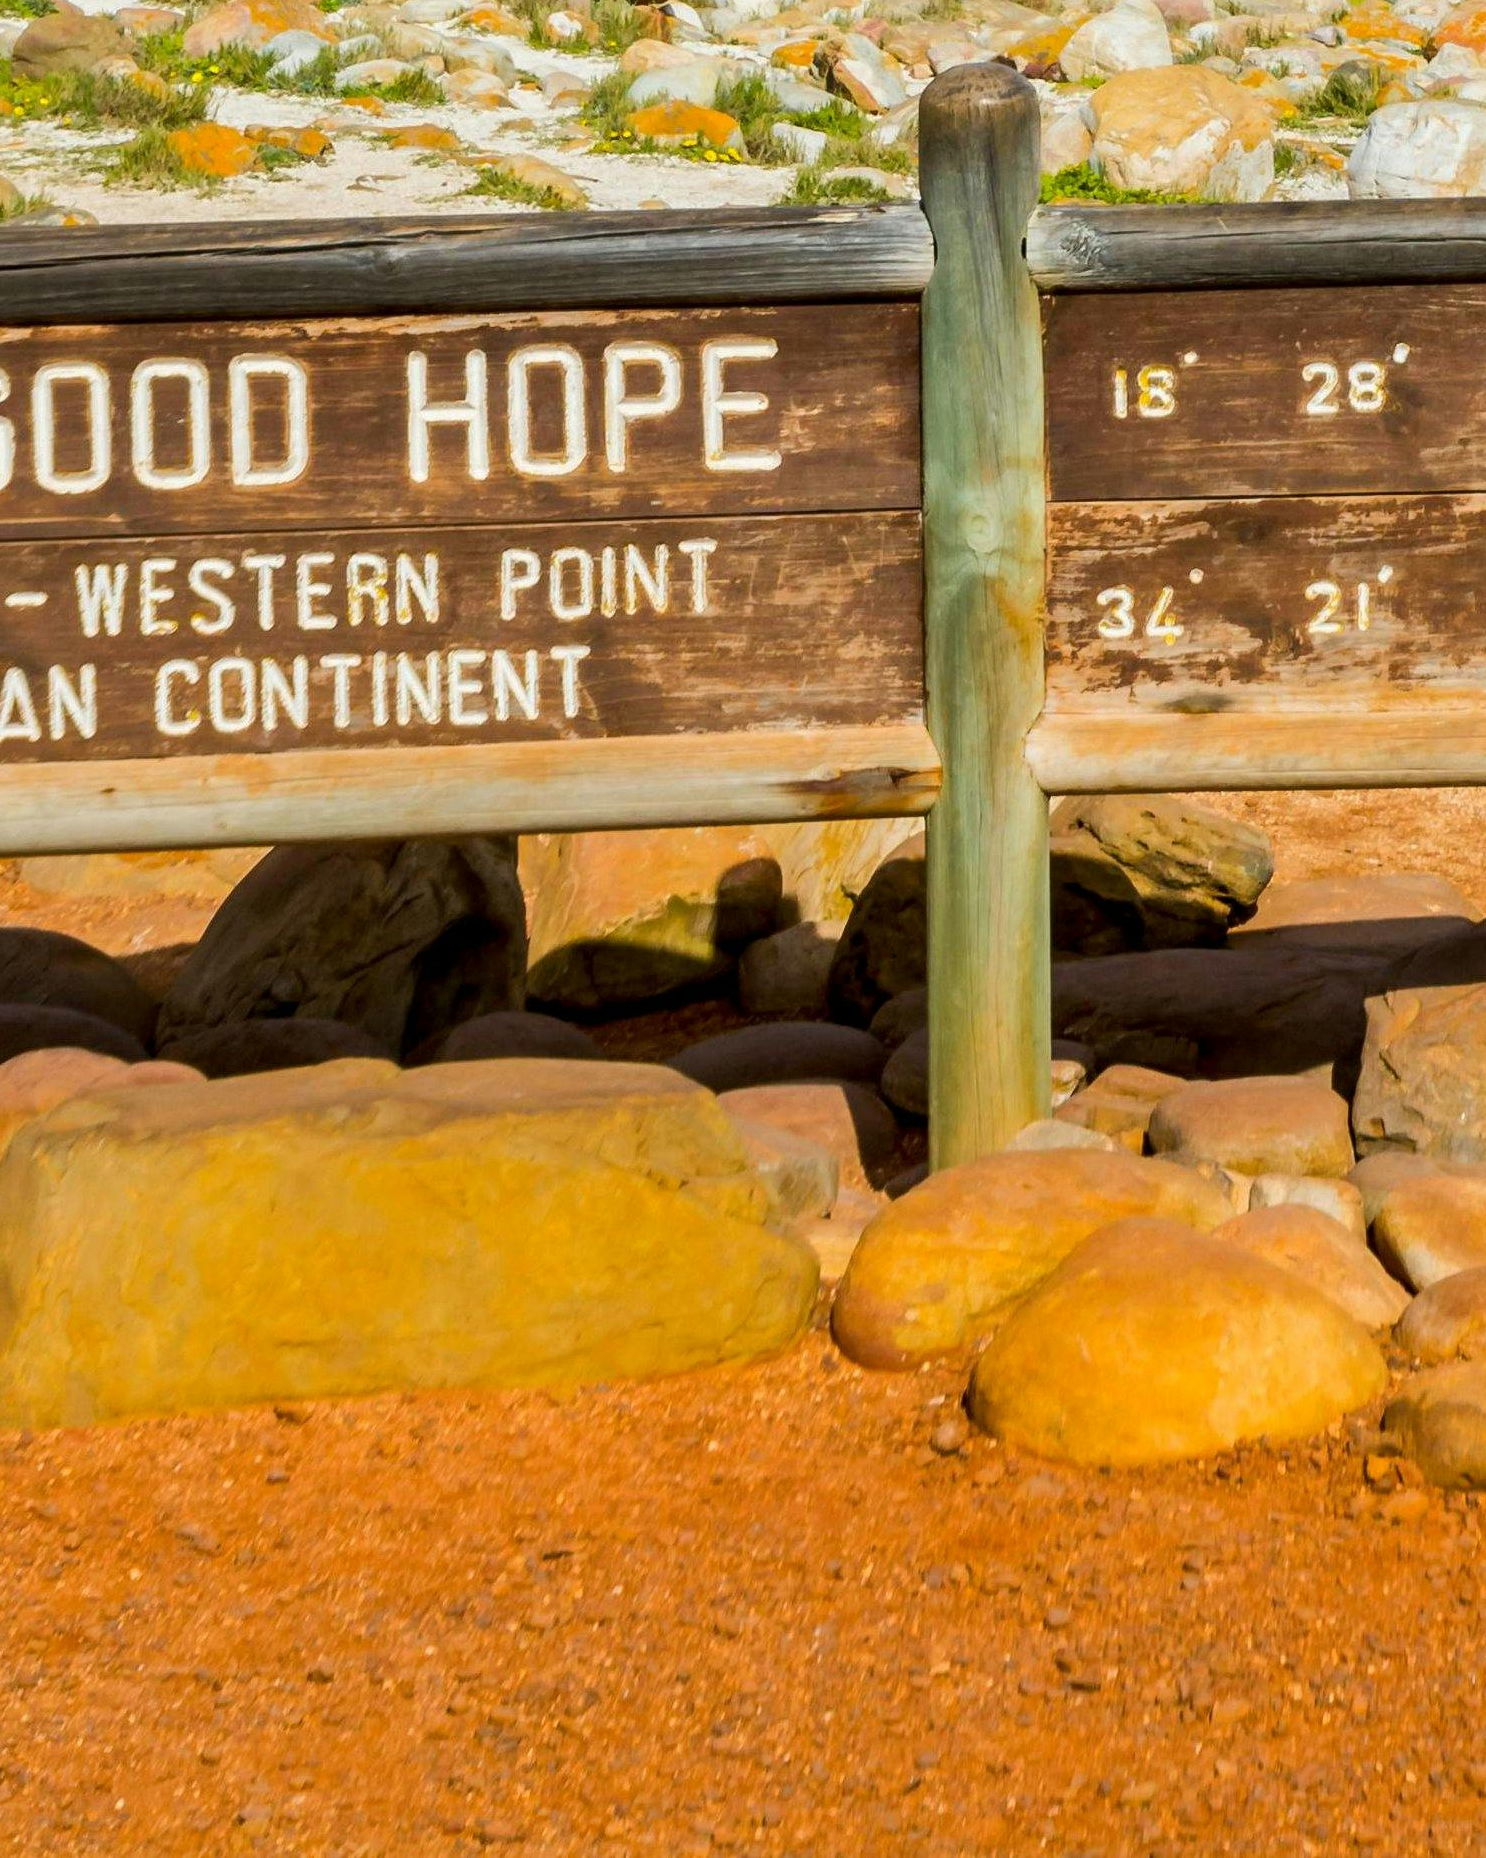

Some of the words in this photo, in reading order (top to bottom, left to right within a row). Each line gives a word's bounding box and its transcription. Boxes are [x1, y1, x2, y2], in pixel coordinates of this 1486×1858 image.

[405, 338, 782, 482] HOPE
[499, 538, 718, 621] POINT
[153, 644, 592, 736] CONTINENT
